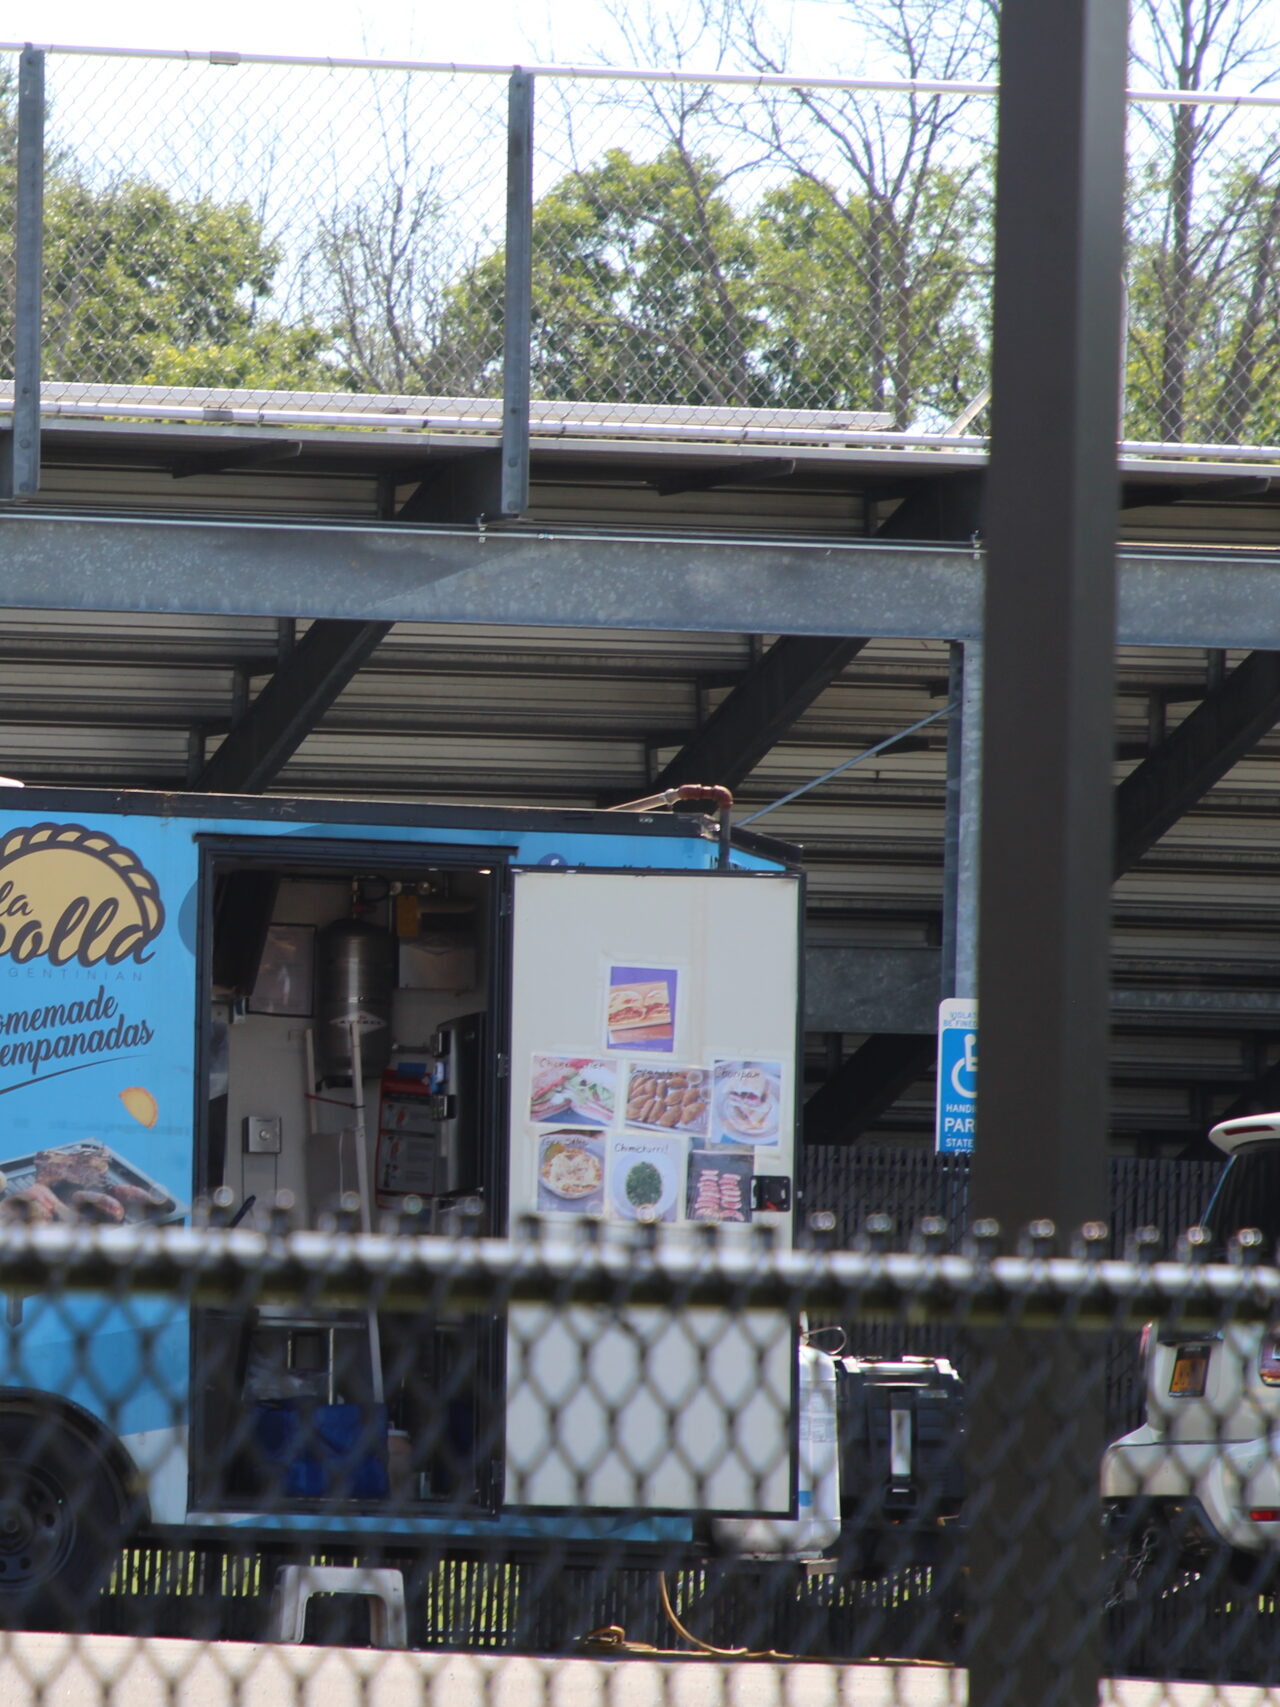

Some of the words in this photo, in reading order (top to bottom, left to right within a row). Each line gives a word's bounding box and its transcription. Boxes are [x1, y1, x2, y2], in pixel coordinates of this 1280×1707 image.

[950, 1011, 977, 1020] VIOLAT
[945, 1103, 975, 1113] HANDI
[944, 1117, 975, 1133] PAR
[945, 1138, 974, 1148] STATE
